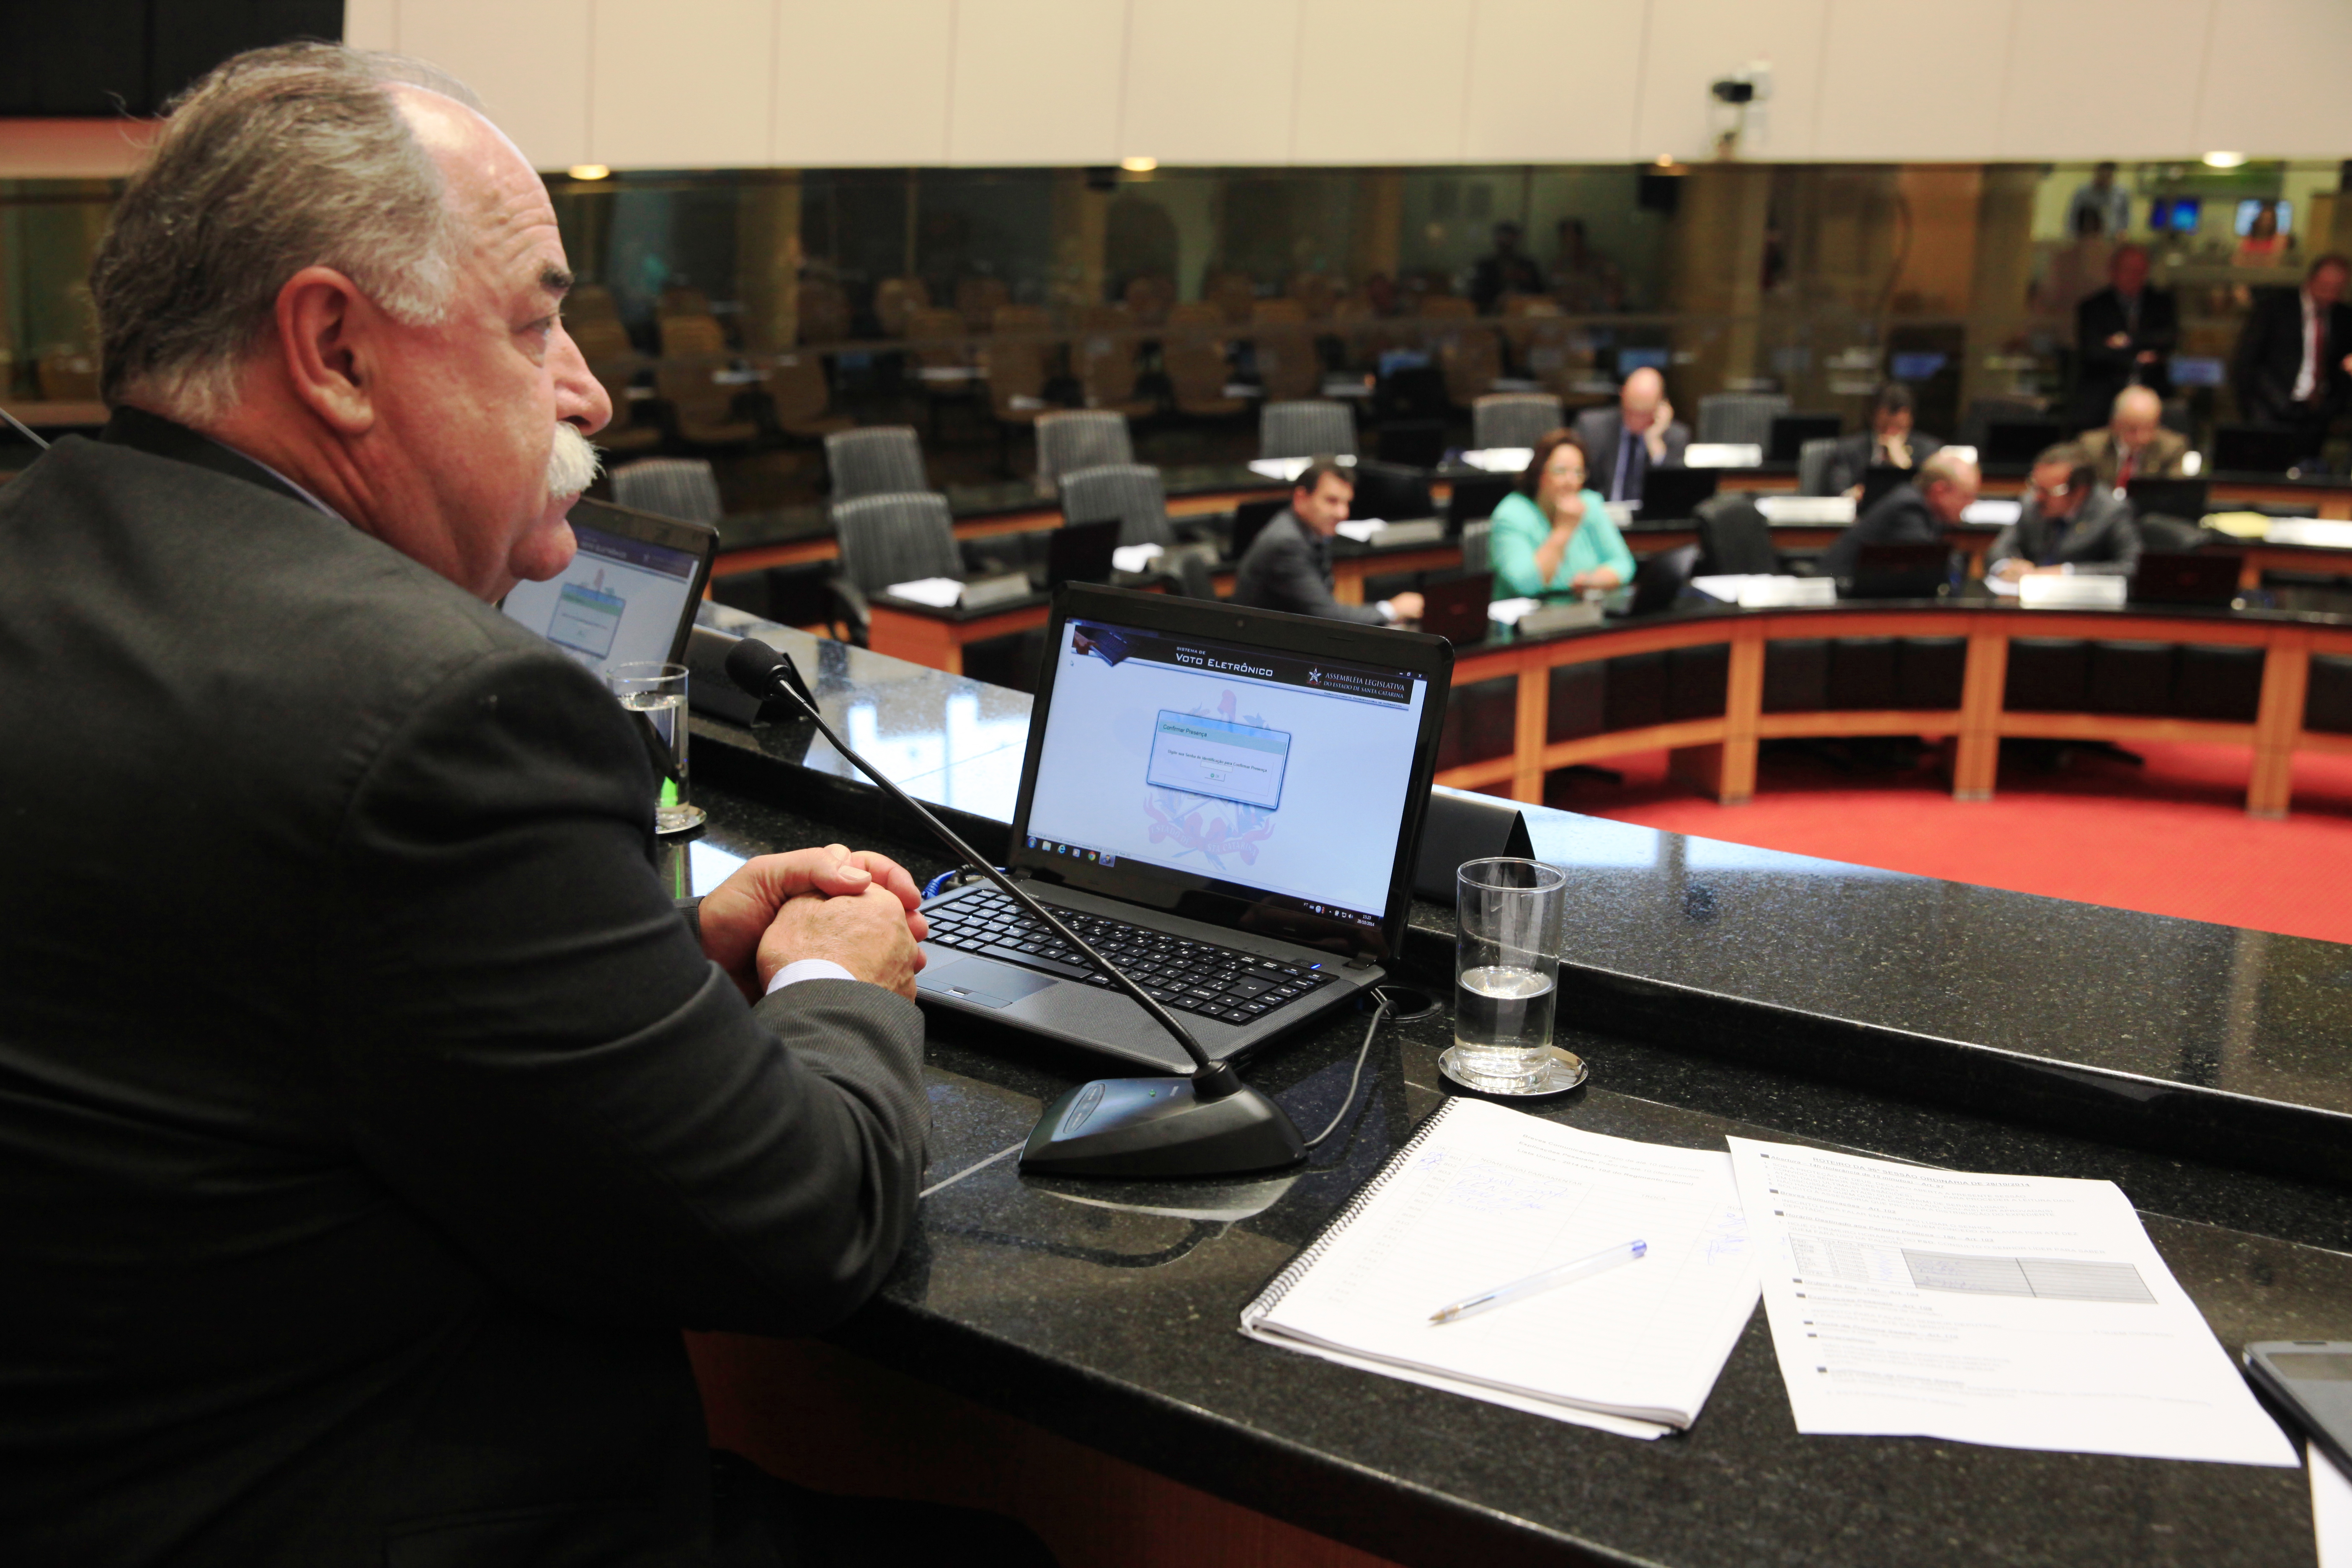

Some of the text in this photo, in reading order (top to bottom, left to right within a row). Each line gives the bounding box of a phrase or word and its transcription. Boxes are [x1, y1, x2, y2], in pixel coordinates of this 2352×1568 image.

[1176, 653, 1273, 676] VOTO ELETRÔNICO
[1326, 673, 1404, 691] ASSEMBLÉIA LEGISLATIVA
[1378, 690, 1403, 699] CATARINA
[1163, 724, 1207, 737] Confirmar Presença
[1202, 756, 1224, 764] Identificação
[1152, 825, 1180, 838] ESTADO
[1222, 841, 1256, 856] CATARINA
[1523, 1134, 1546, 1143] Breves
[1548, 1142, 1602, 1156] Comunicações:
[1519, 1141, 1560, 1155] Explicações
[1563, 1153, 1596, 1163] Pessoais:
[1481, 1158, 1502, 1166] NOME
[1528, 1171, 1582, 1186] PARLAMENTAR
[1624, 1173, 1663, 1181] Regimento
[1774, 1167, 1807, 1176] CONVIDO
[1817, 1175, 1848, 1184] SENHOR
[1797, 1168, 1837, 1179] PROTEÇÃO
[1813, 1157, 1850, 1167] ROTEIRO
[1883, 1170, 1917, 1179] SESSÃO
[1920, 1176, 1968, 1185] ORDINÁRIA
[1823, 1166, 1859, 1175] (tolerância
[1807, 1196, 1859, 1208] Comunicações
[1815, 1217, 1851, 1227] Destinado
